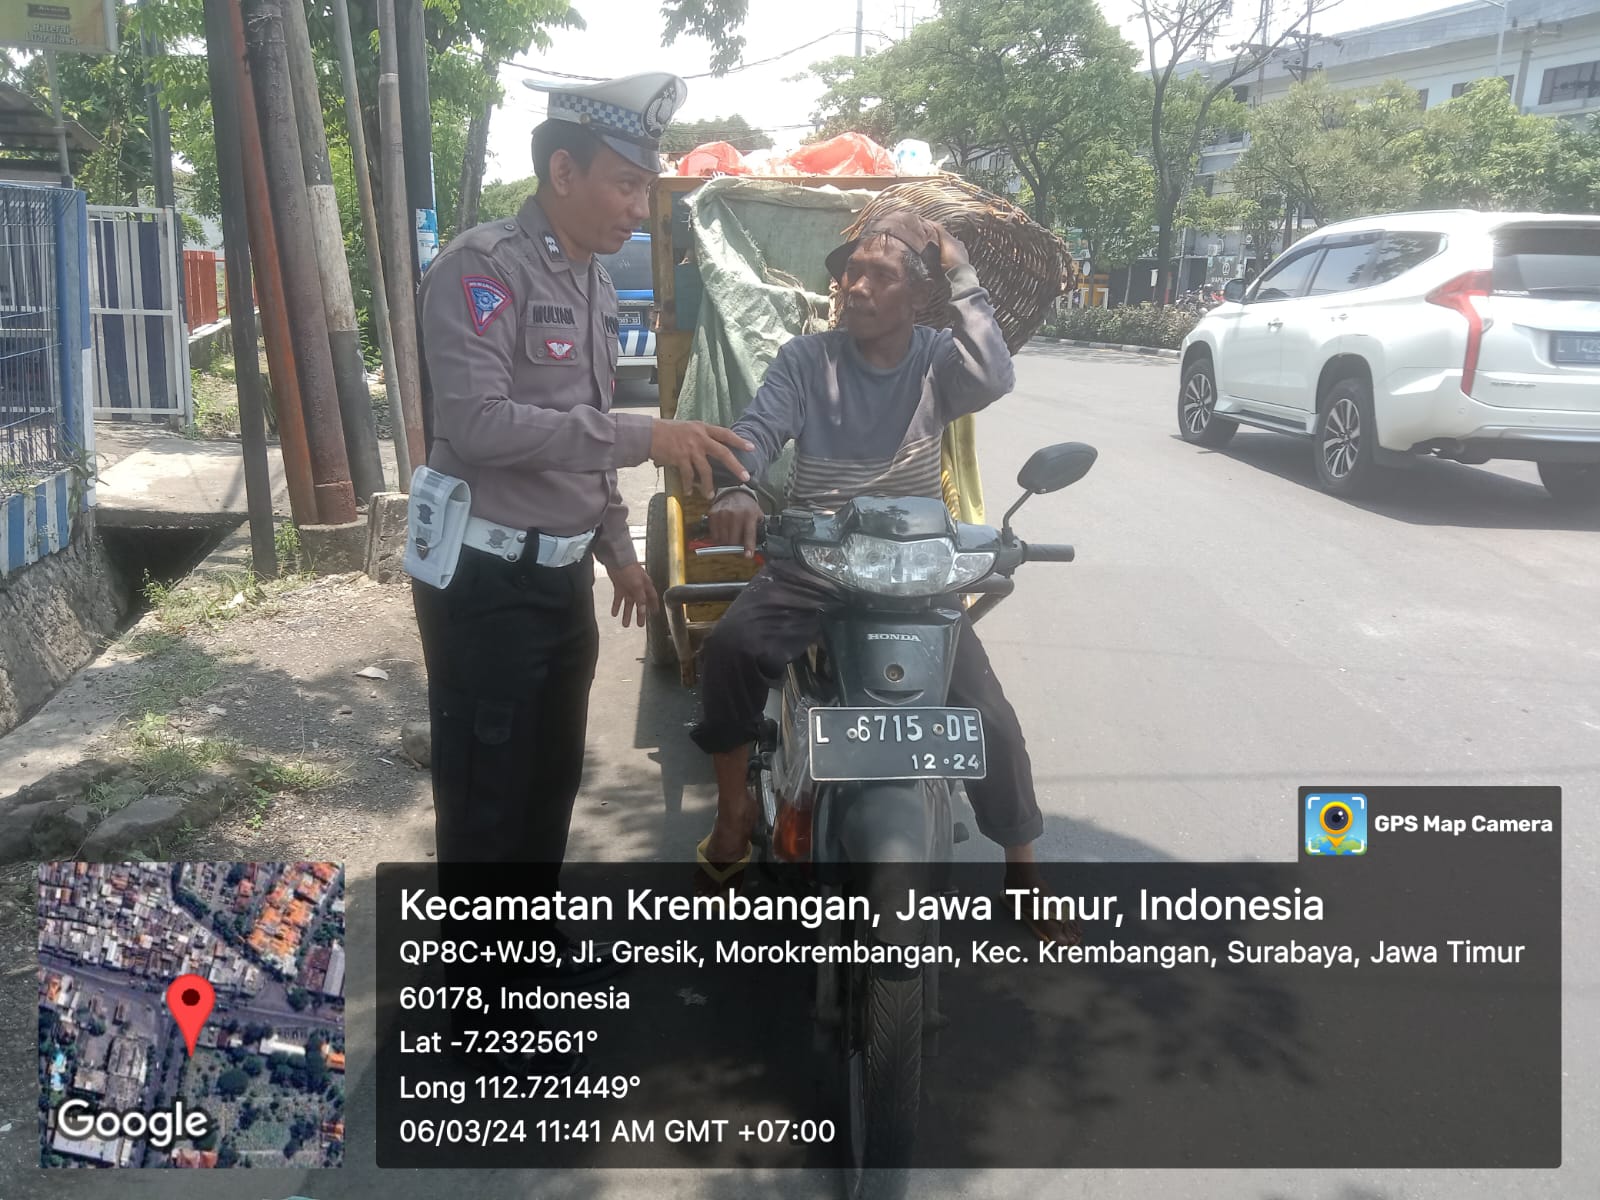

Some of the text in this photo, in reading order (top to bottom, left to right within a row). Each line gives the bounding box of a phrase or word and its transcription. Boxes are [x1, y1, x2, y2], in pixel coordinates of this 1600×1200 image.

[867, 633, 921, 642] HONDA
[815, 714, 979, 744] L 6715 DE
